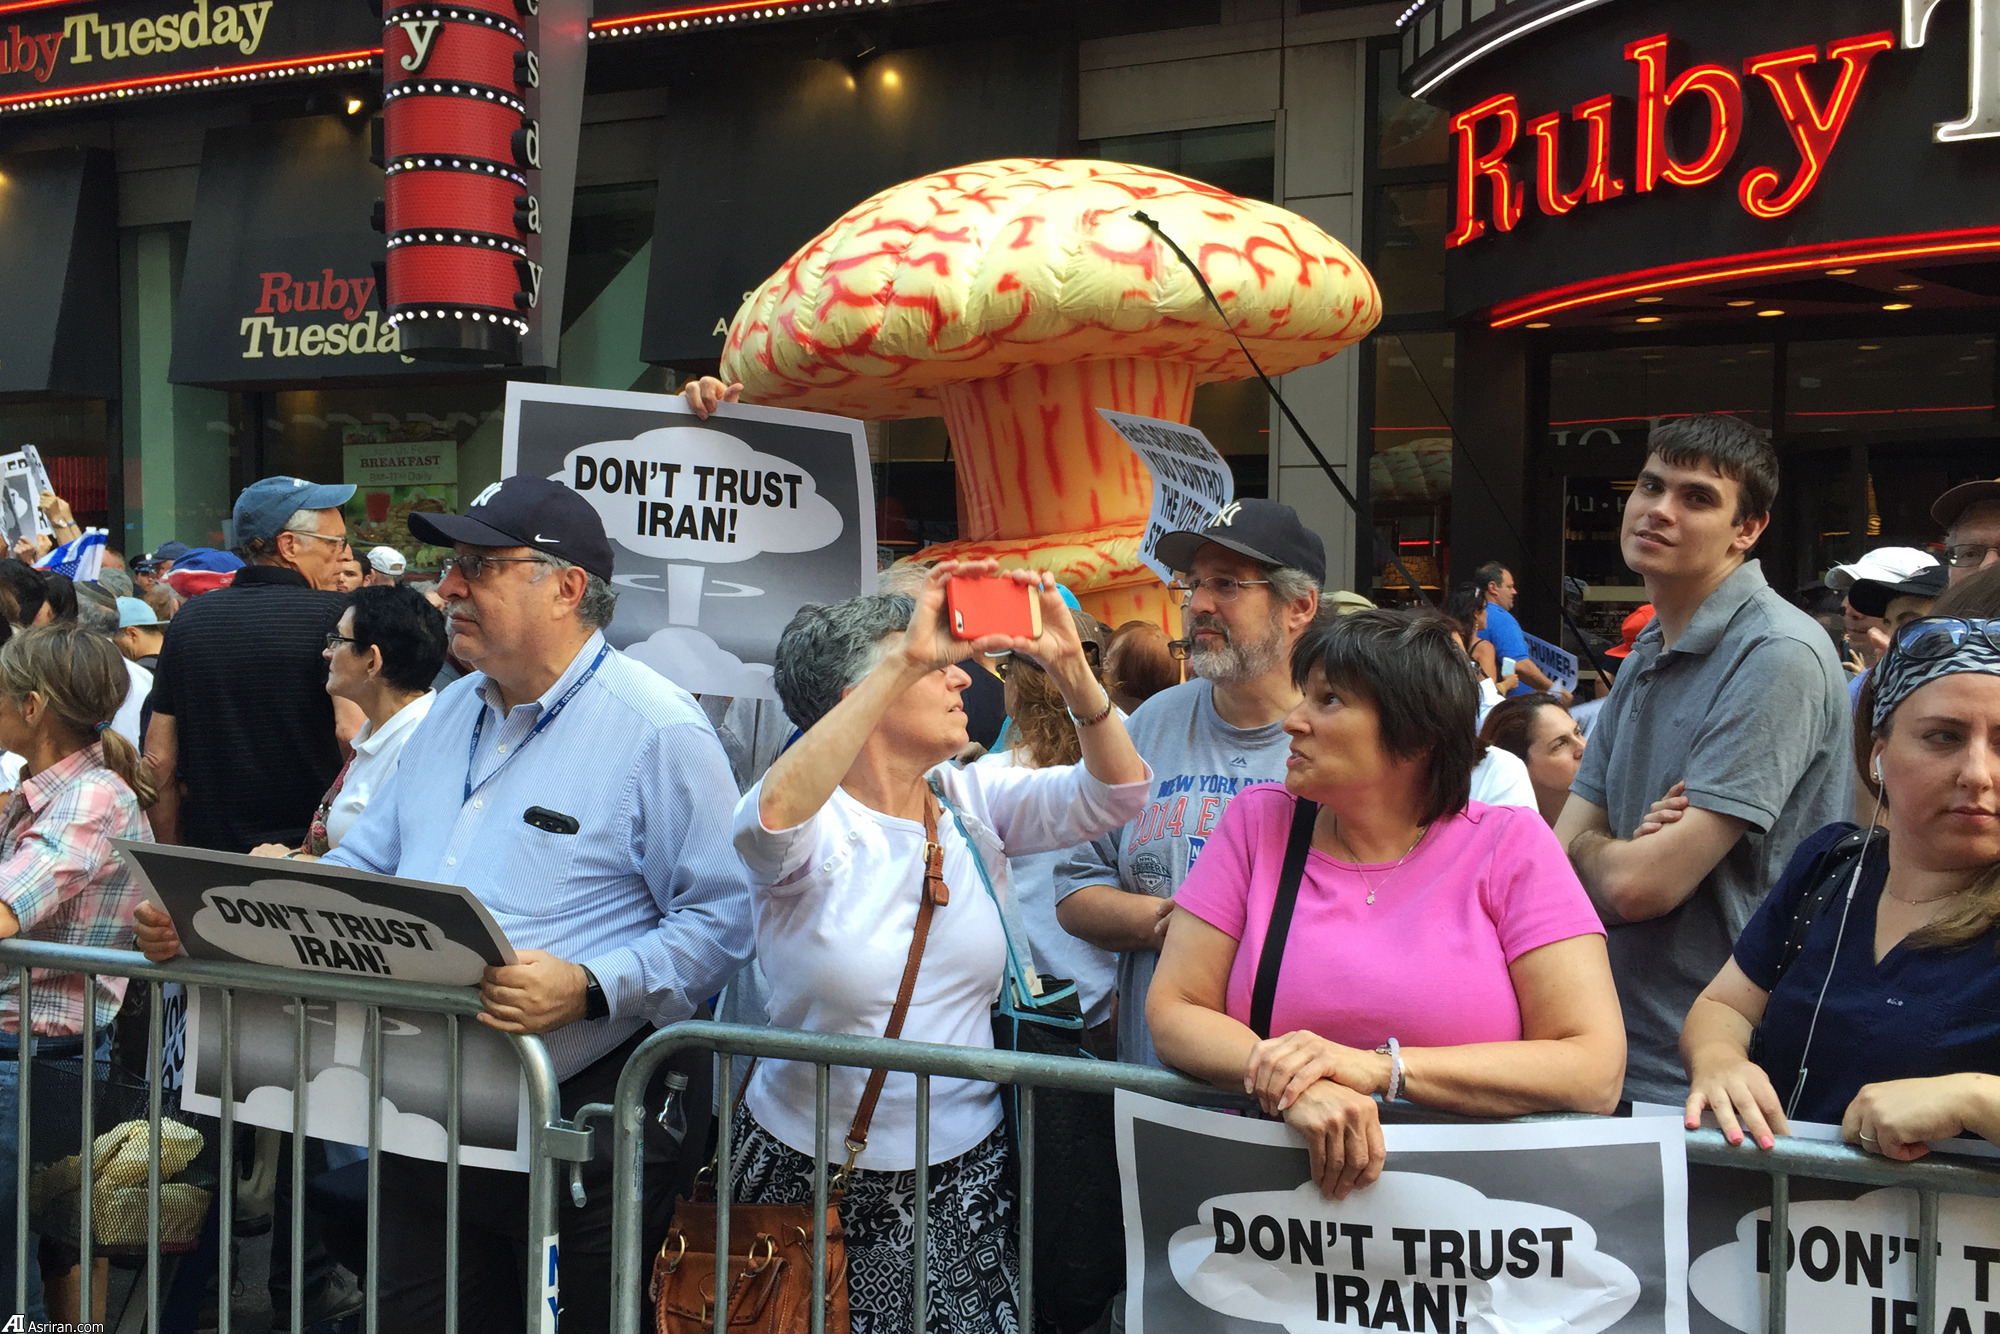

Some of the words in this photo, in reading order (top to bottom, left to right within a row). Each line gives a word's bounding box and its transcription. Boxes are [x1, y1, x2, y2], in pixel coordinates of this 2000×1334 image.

[64, 0, 273, 64] Tuesday
[1446, 31, 1895, 249] Ruby
[255, 268, 376, 321] Ruby
[240, 311, 416, 364] Tuesda
[360, 455, 441, 468] BREAKFAST
[574, 455, 682, 498] DON'T
[693, 465, 803, 509] TRUST
[1141, 449, 1177, 483] YOU
[1171, 456, 1226, 508] CONTROL
[637, 501, 738, 543] IRAN!
[1161, 483, 1180, 523] THE
[562, 682, 581, 704] CENTRAL
[580, 668, 594, 685] OFFICE
[1157, 774, 1195, 798] NEW
[1199, 774, 1239, 796] YORK
[1128, 796, 1188, 856] 2014
[210, 895, 316, 934] DON'T
[317, 910, 434, 951] TRUST
[289, 934, 392, 975] IRAN!
[1212, 1207, 1374, 1271] DON'T
[1392, 1227, 1573, 1281] TRUST
[1315, 1272, 1468, 1334] IRAN!
